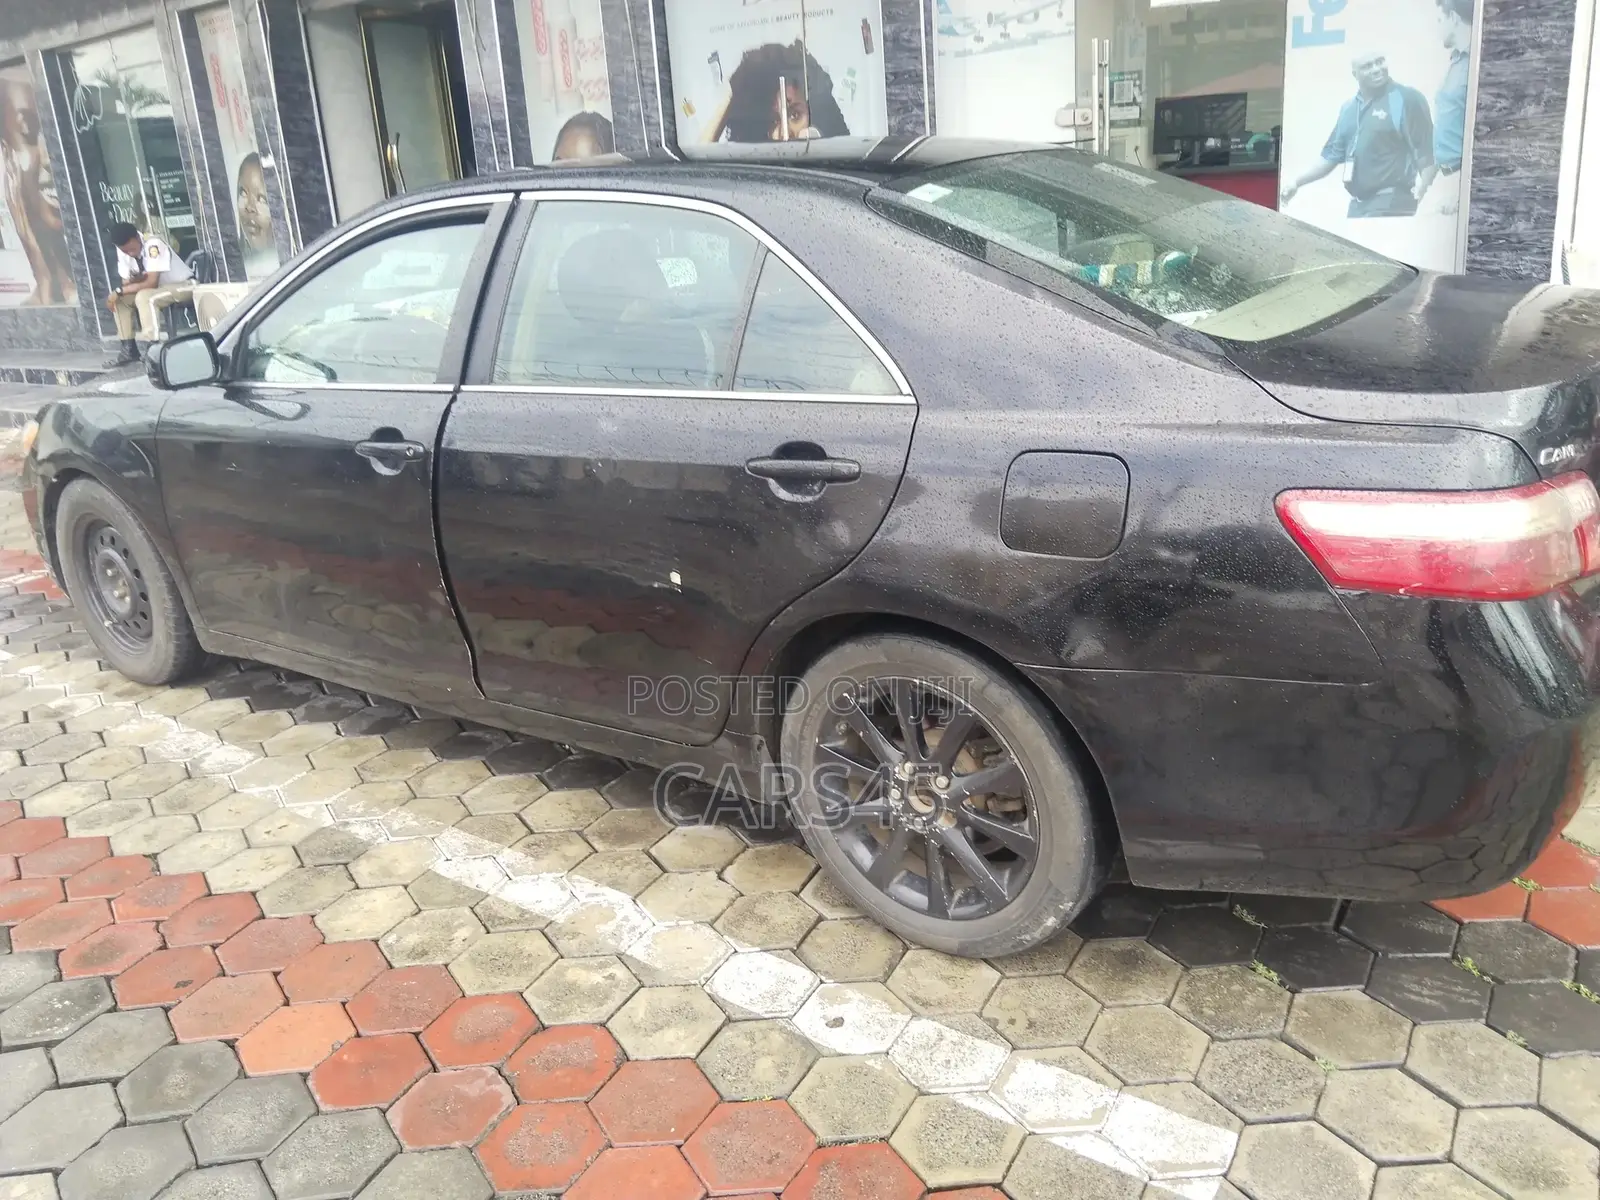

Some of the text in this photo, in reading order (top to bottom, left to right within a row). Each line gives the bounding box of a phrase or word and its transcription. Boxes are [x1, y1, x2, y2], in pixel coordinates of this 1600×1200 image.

[775, 13, 800, 23] BEAUTY
[99, 180, 134, 203] Beauty
[1540, 443, 1584, 466] CAM
